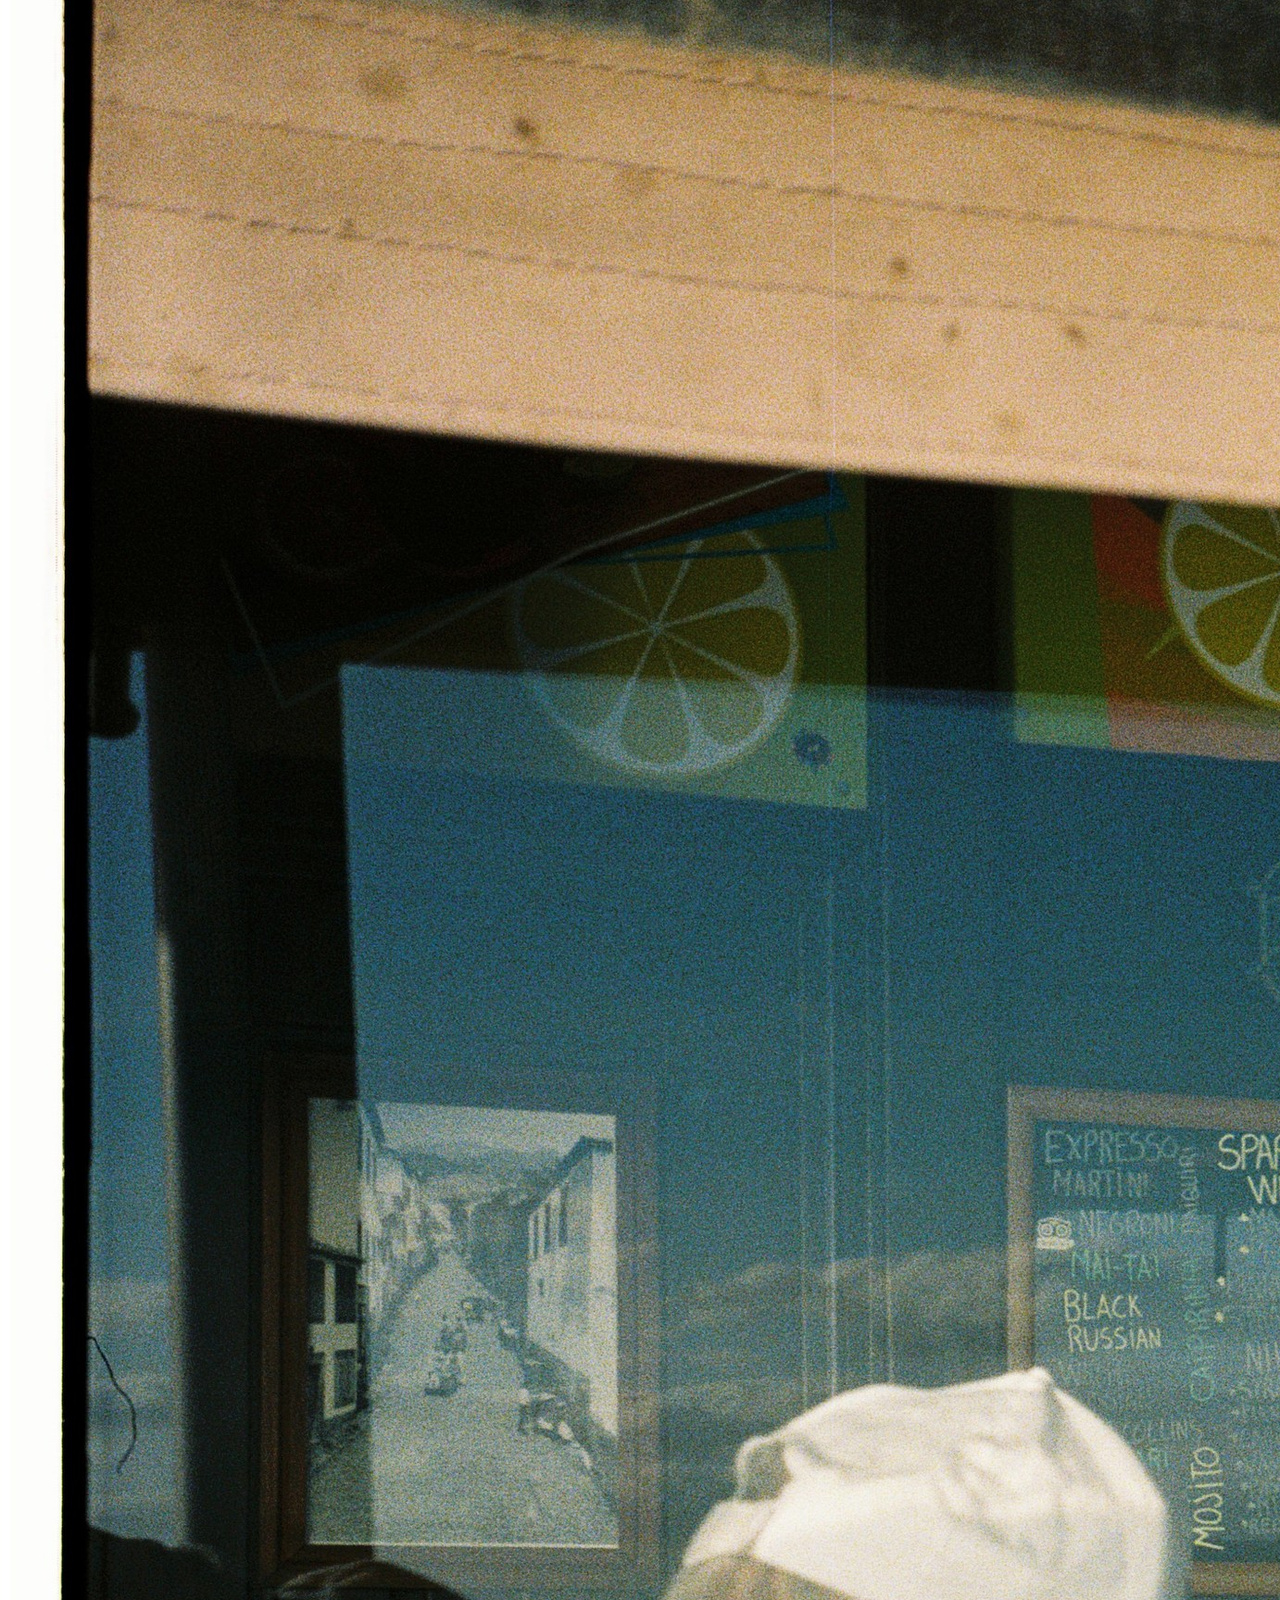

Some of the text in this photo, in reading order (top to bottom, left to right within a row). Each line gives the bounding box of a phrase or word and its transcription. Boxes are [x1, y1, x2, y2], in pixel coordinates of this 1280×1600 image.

[1045, 1129, 1179, 1165] EXPRESSO
[1078, 1209, 1175, 1241] NEGRONI
[1063, 1288, 1142, 1323] BLACK
[1067, 1322, 1162, 1353] RUSSIAN
[1189, 1446, 1226, 1551] MOJITO
